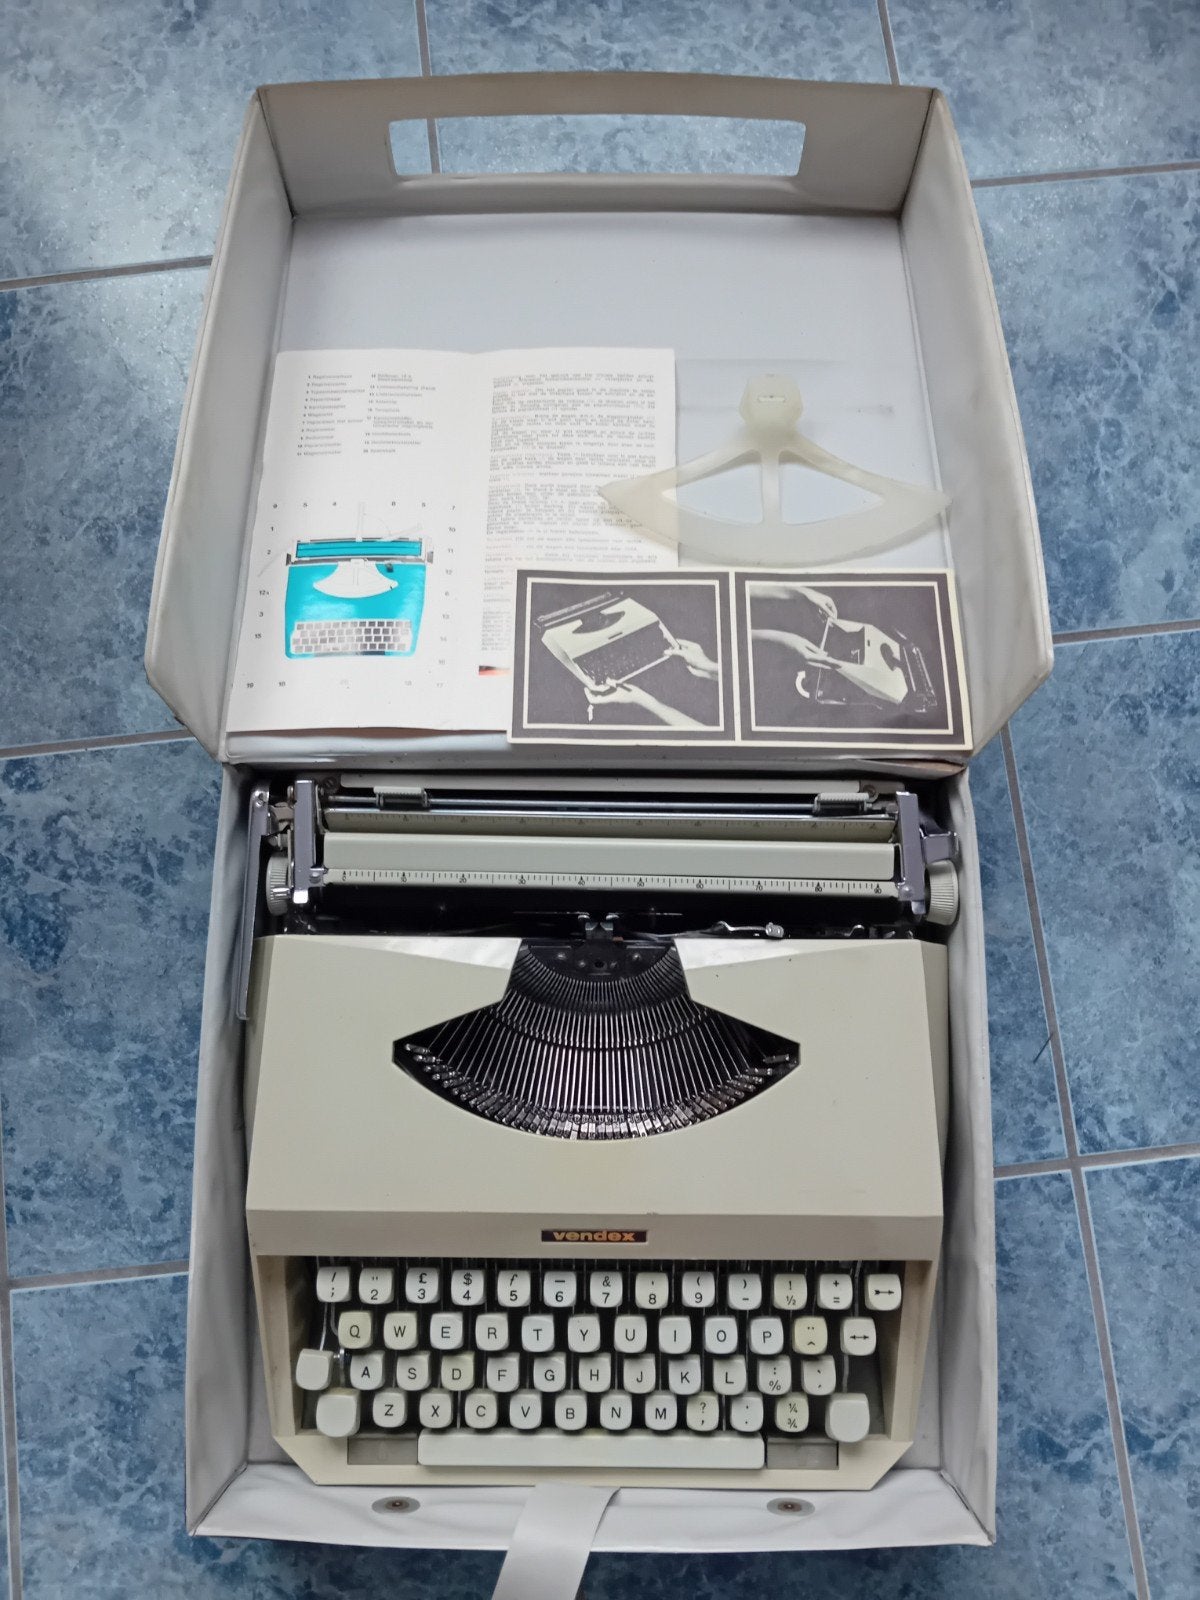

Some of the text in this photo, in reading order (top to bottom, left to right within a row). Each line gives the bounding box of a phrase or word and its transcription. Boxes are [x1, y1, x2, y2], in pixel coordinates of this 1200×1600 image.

[458, 876, 467, 884] 20
[755, 884, 764, 892] 70
[553, 1231, 635, 1242] vendex
[418, 1272, 428, 1284] £
[462, 1272, 473, 1286] $
[602, 1276, 613, 1287] &
[370, 1289, 378, 1300] 2
[418, 1288, 426, 1300] 3
[462, 1290, 471, 1300] 4
[510, 1290, 518, 1302] 5
[555, 1291, 564, 1302] 6
[602, 1292, 610, 1304] 7
[648, 1293, 656, 1305] 8
[694, 1292, 703, 1304] 9
[349, 1324, 360, 1339] Q
[394, 1326, 406, 1338] W
[441, 1326, 451, 1338] E
[488, 1327, 497, 1339] R
[533, 1328, 542, 1341] T
[580, 1329, 588, 1341] Y
[625, 1329, 636, 1342] U
[716, 1330, 727, 1342] O
[762, 1331, 772, 1344] P
[361, 1366, 370, 1378] A
[408, 1367, 417, 1380] S
[452, 1368, 462, 1380] D
[498, 1369, 507, 1381] F
[544, 1369, 555, 1382] G
[590, 1369, 599, 1381] H
[636, 1371, 643, 1383] J
[680, 1371, 690, 1383] K
[725, 1372, 734, 1384] L
[768, 1380, 781, 1391] %
[384, 1404, 394, 1416] Z
[431, 1405, 440, 1417] X
[476, 1405, 486, 1418] C
[521, 1406, 530, 1418] V
[566, 1408, 575, 1420] B
[611, 1406, 621, 1418] N
[655, 1408, 666, 1420] M
[700, 1402, 706, 1413] ?
